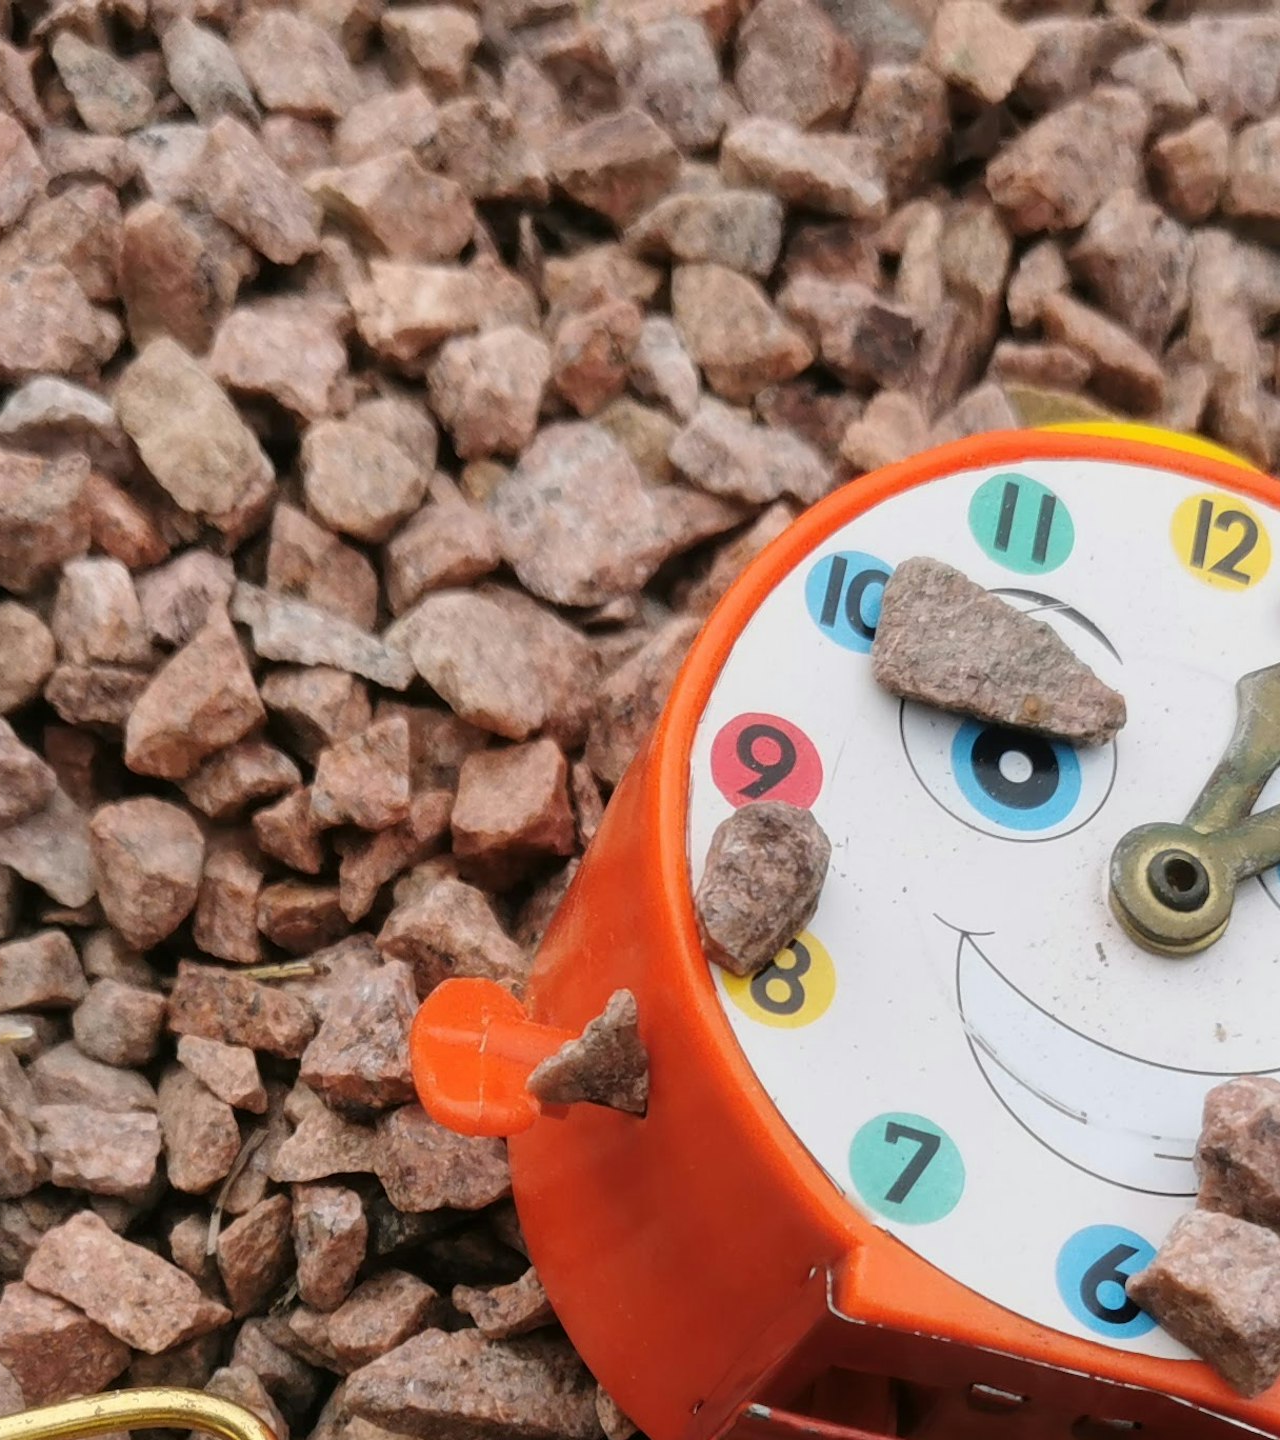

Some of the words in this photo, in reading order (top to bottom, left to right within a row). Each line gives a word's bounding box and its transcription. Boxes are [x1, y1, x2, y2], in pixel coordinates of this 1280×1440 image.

[994, 482, 1056, 565] 11
[1190, 499, 1258, 584] 12
[820, 556, 891, 641] 10
[736, 724, 797, 800] 9
[750, 938, 811, 1014] 8
[884, 1122, 941, 1204] 7
[1080, 1243, 1141, 1324] 6
